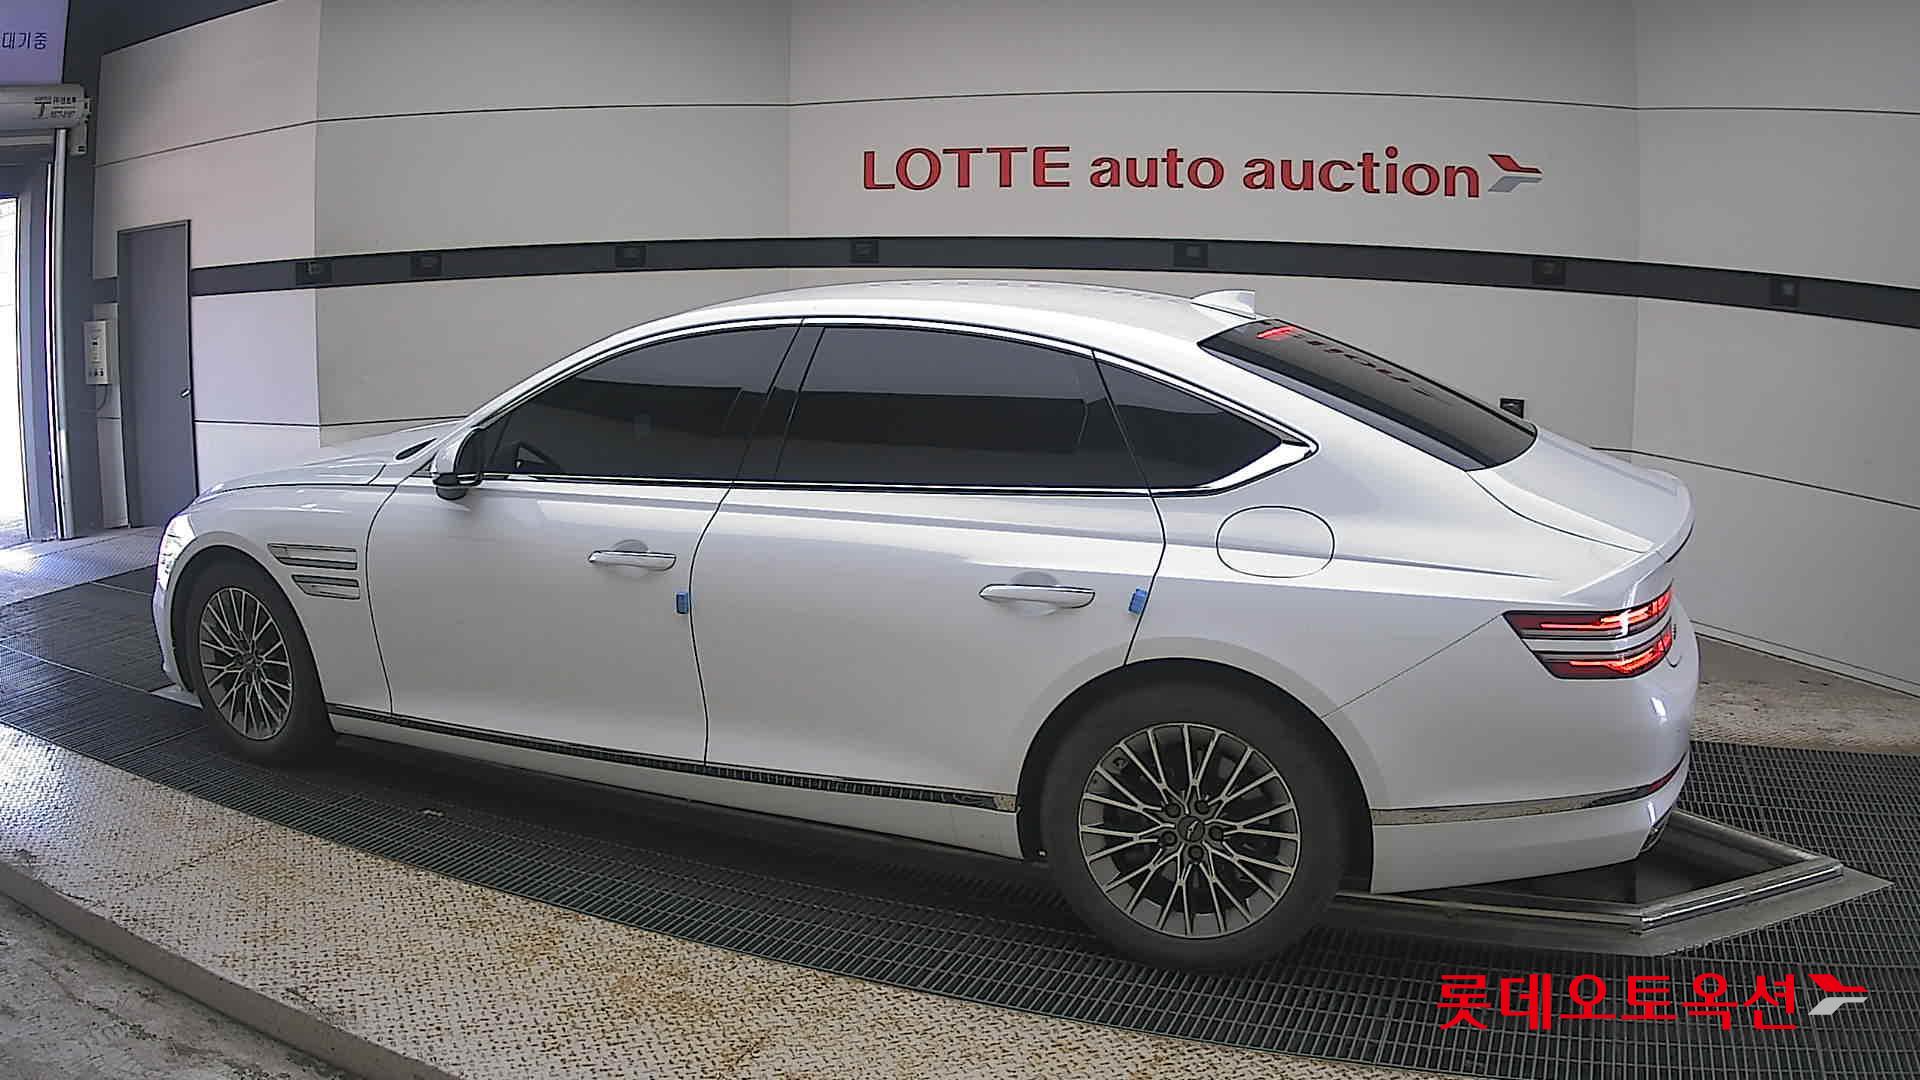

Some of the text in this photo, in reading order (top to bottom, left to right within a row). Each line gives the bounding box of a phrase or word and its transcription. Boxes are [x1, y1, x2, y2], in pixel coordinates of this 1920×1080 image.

[2, 31, 47, 50] 대기중
[863, 145, 1480, 198] LOTTE auto auction
